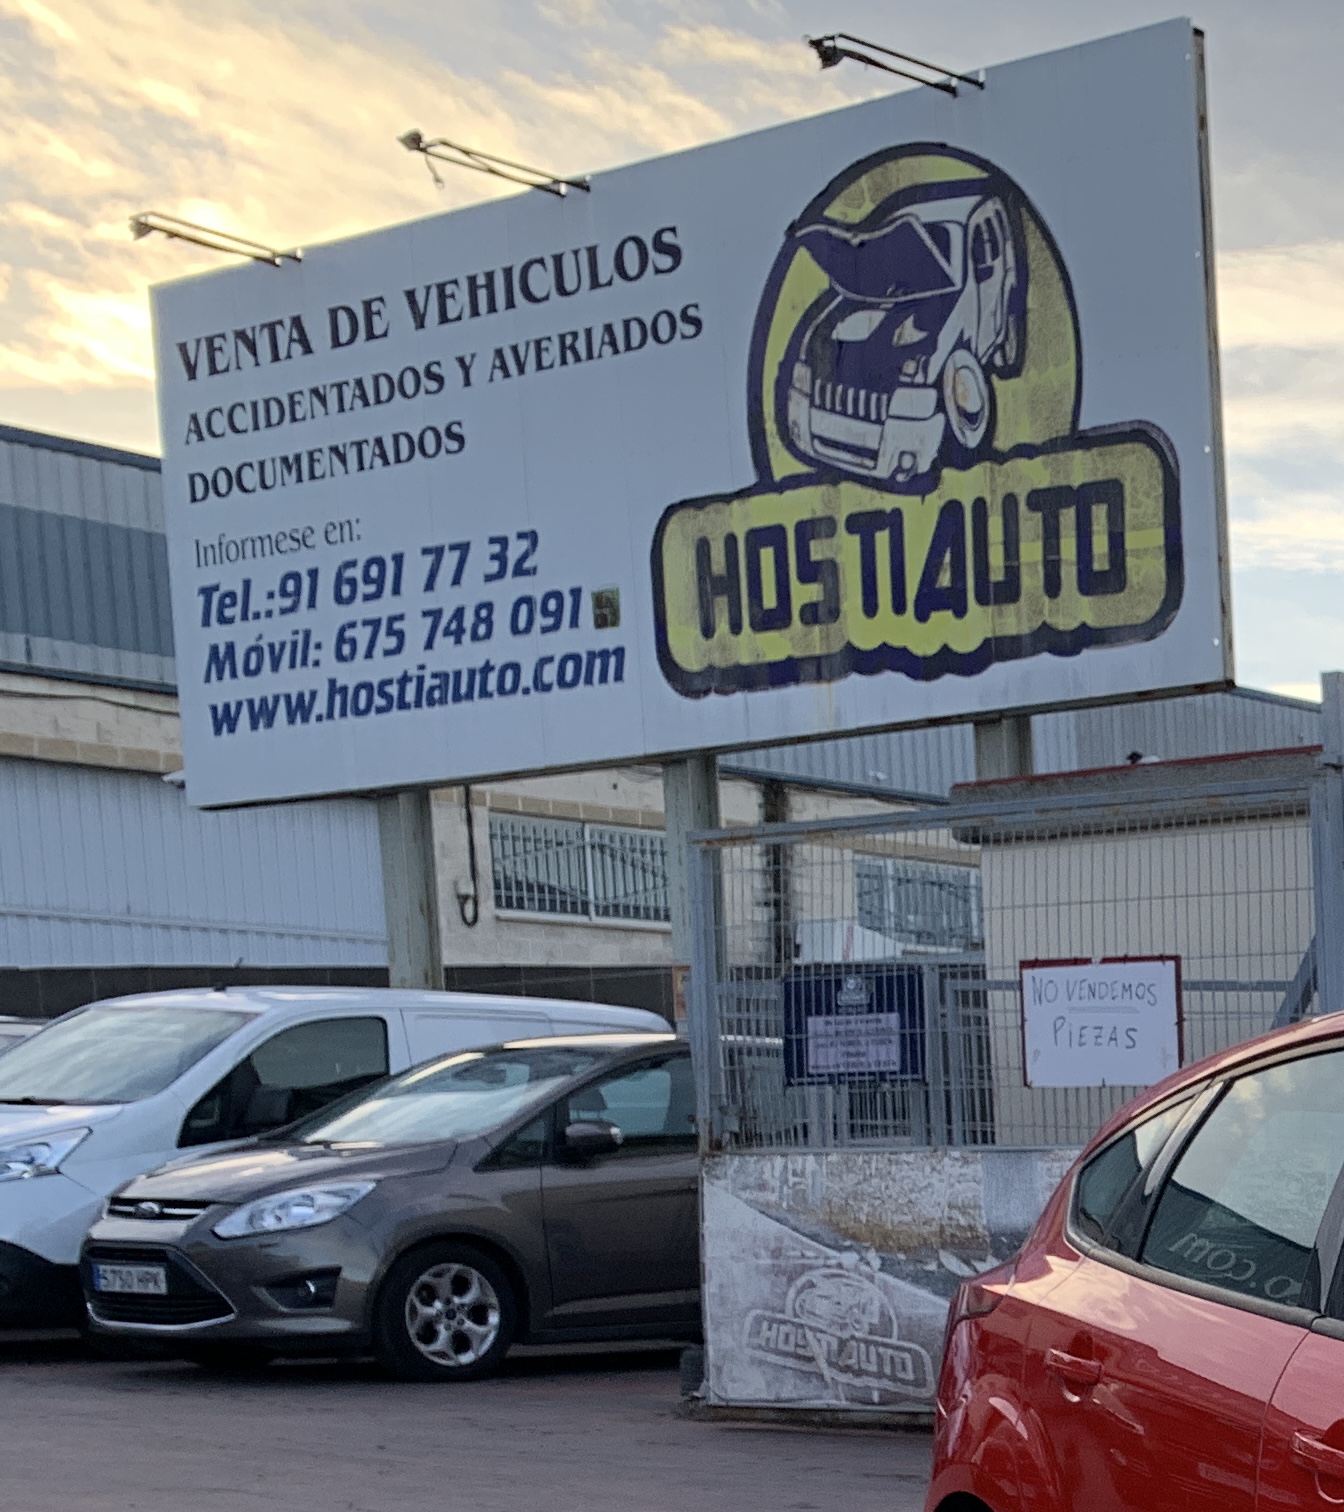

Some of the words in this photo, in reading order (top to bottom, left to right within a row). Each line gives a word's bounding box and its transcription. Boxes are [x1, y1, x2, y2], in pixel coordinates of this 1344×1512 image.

[175, 313, 314, 382] VENTA
[328, 296, 390, 349] DE
[403, 226, 683, 331] VEHICULOS
[185, 360, 445, 445] ACCIDENTADOS
[455, 352, 477, 388] Y
[488, 302, 703, 383] AVERIADOS
[187, 420, 466, 504] DOCUMENTADOS
[194, 525, 316, 568] Informese
[324, 518, 361, 546] en:
[333, 552, 405, 606] 691
[420, 540, 471, 593] 77
[484, 529, 539, 583] 32
[204, 628, 322, 684] Móvil:
[335, 613, 405, 663] 675
[421, 601, 494, 651] 748
[509, 586, 583, 637] 091
[209, 645, 626, 737] www.hostiauto.com
[1031, 975, 1059, 1006] NO
[1066, 977, 1157, 1007] VENDEMOS
